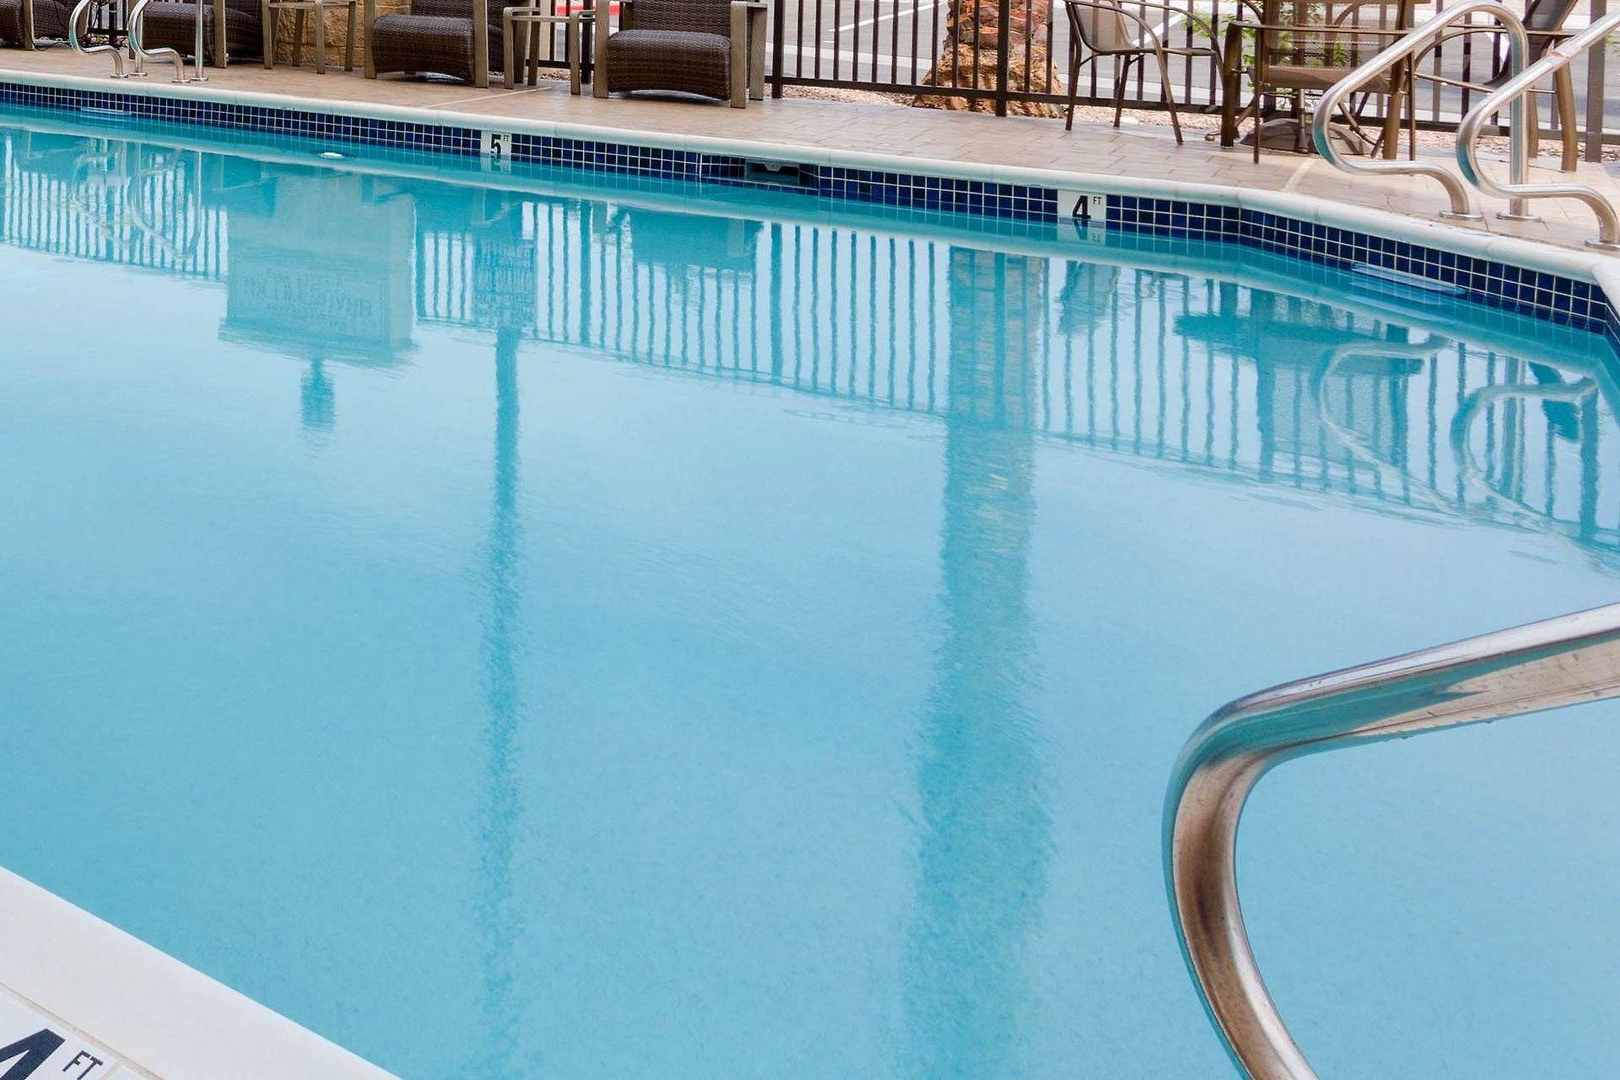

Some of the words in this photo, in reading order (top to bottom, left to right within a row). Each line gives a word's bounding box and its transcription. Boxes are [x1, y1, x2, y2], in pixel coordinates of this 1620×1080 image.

[491, 134, 501, 154] 5
[1073, 195, 1091, 219] 4
[1093, 196, 1101, 205] FT
[62, 1050, 103, 1080] FT
